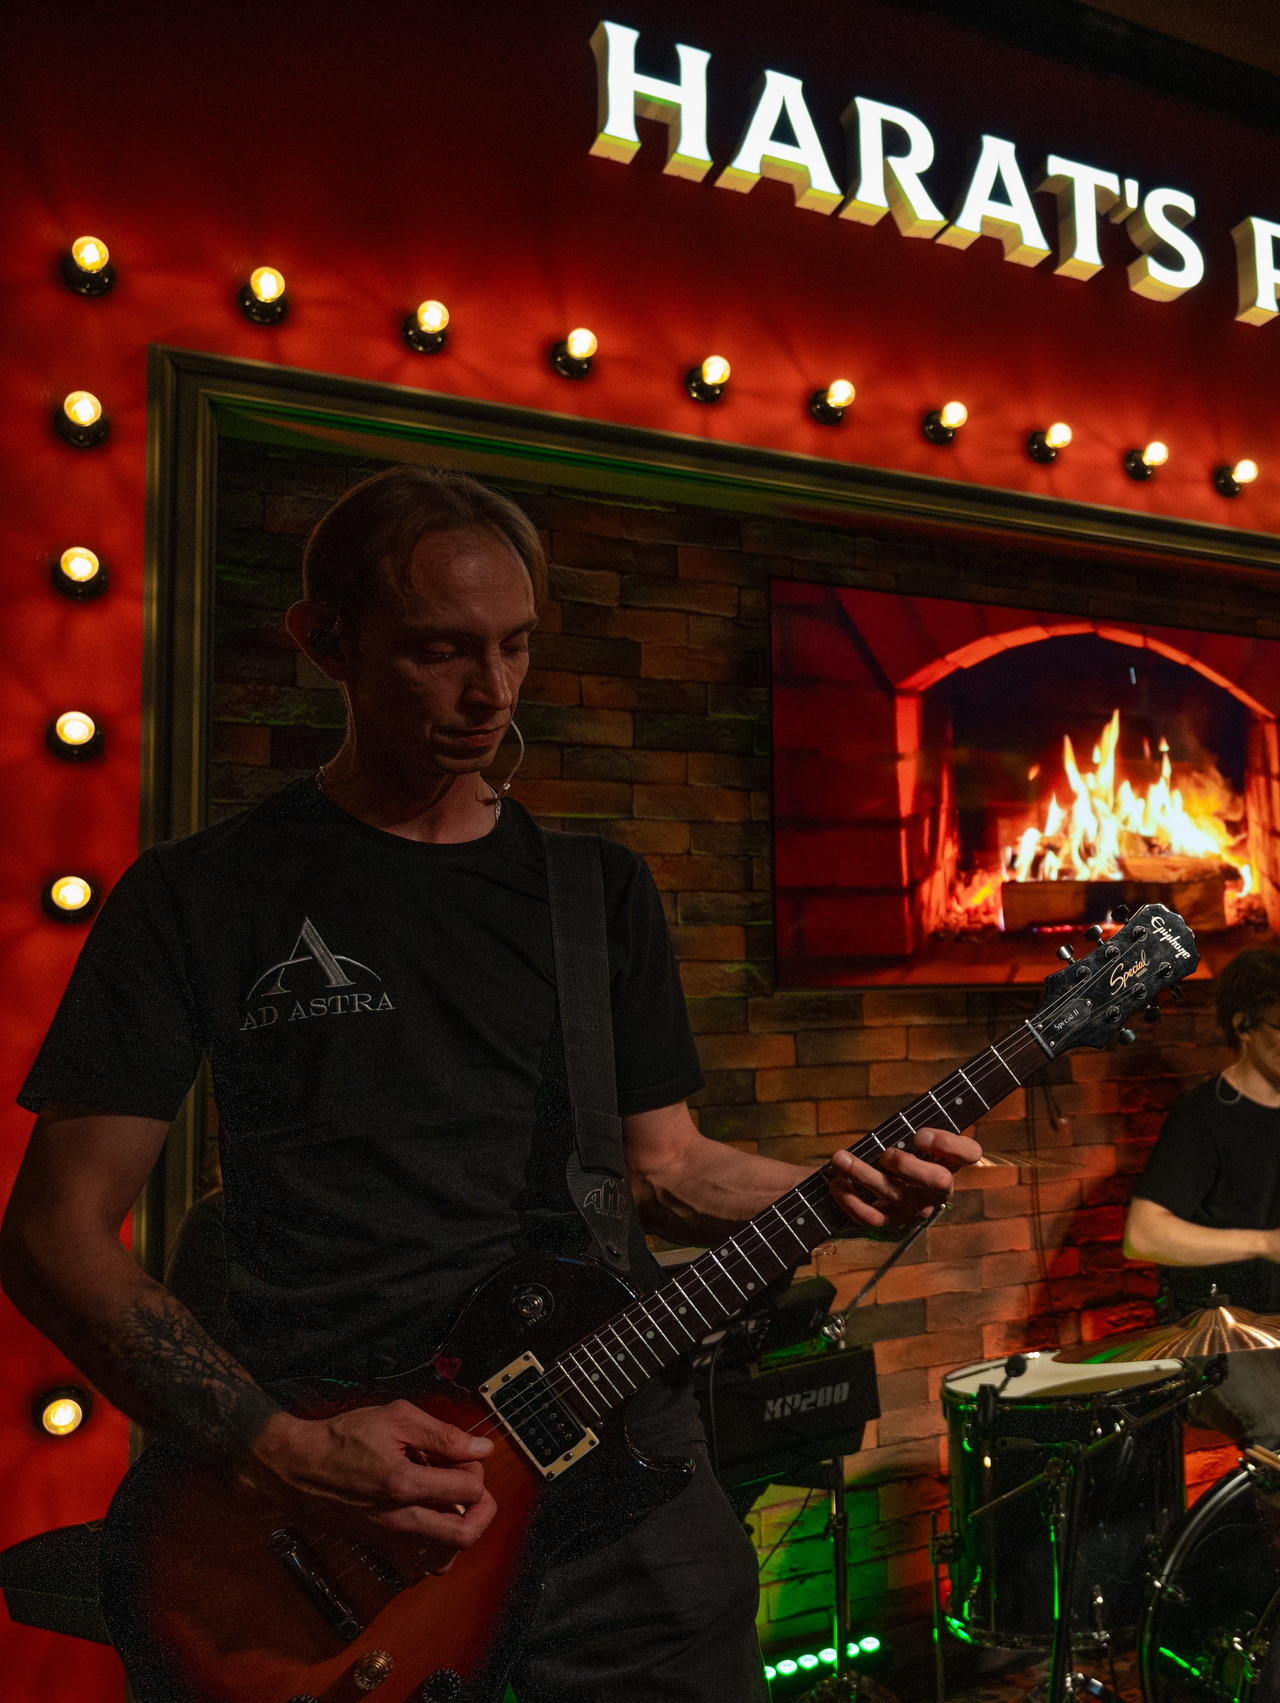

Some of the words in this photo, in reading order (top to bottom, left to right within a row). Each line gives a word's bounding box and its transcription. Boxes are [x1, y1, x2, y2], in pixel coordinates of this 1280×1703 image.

[597, 20, 1204, 295] HARAT'S
[1151, 916, 1192, 959] Epiphone
[1110, 950, 1150, 995] Special
[240, 1006, 279, 1031] AD
[288, 992, 396, 1021] ASTRA
